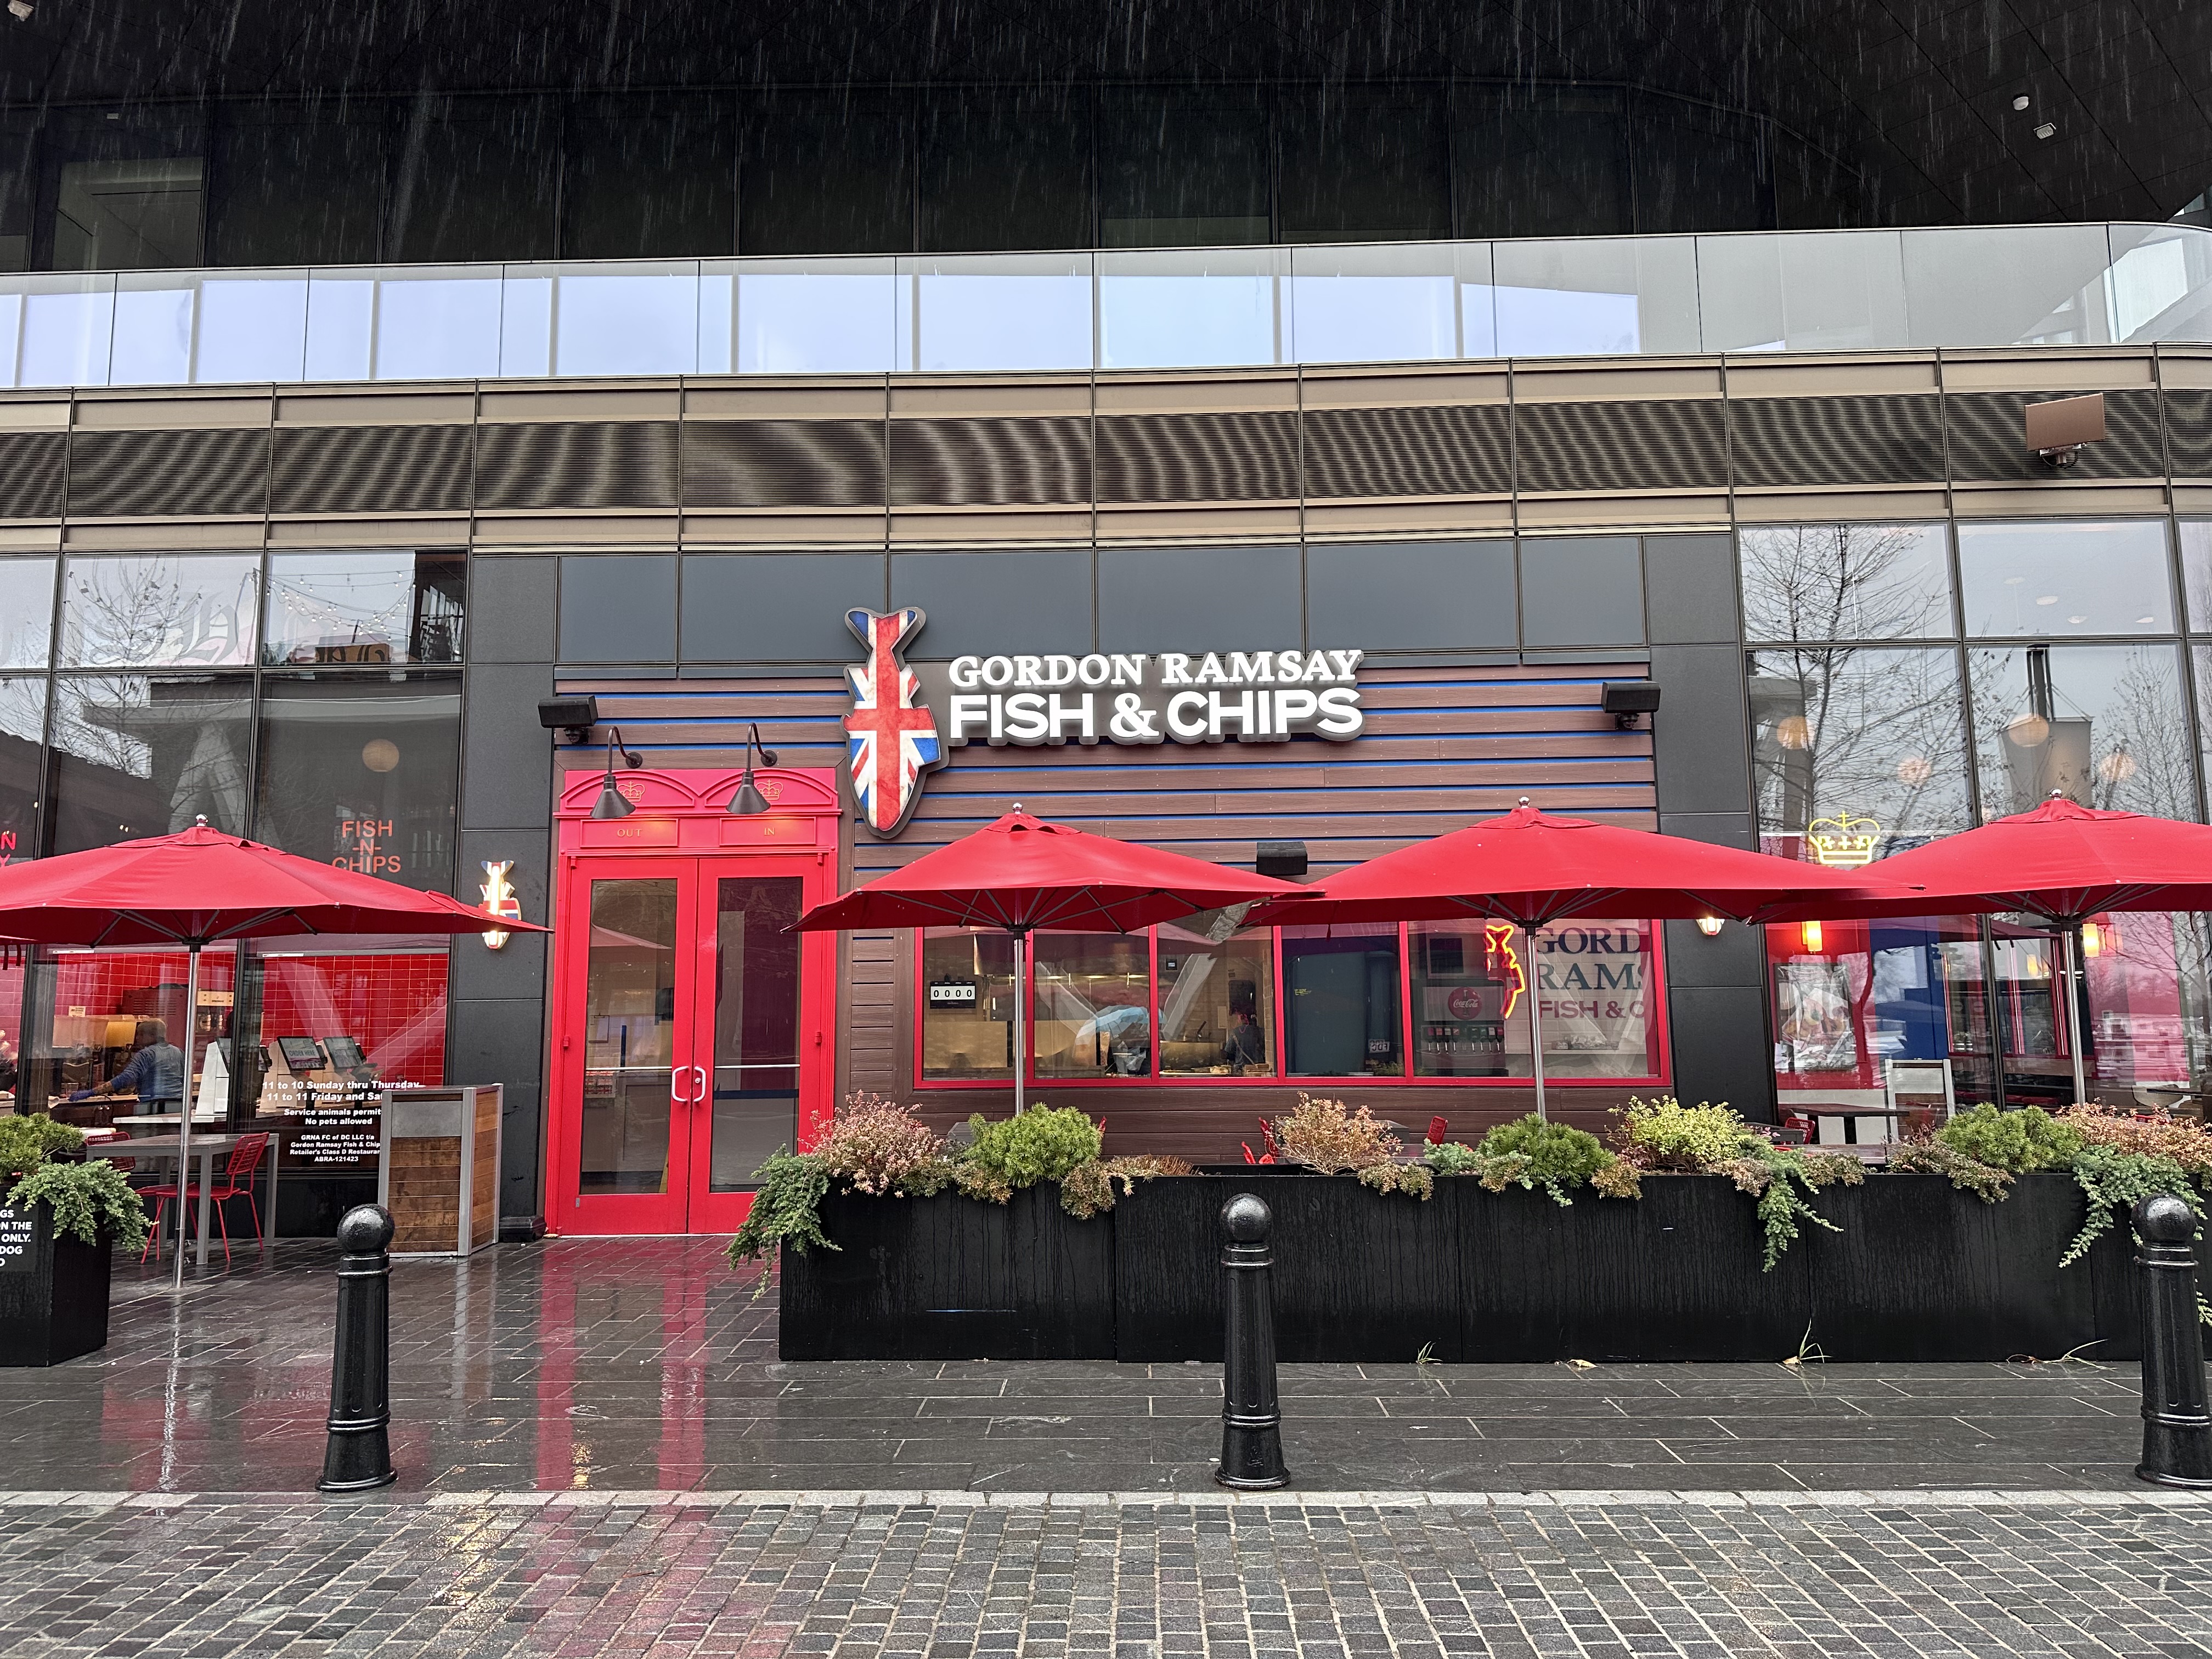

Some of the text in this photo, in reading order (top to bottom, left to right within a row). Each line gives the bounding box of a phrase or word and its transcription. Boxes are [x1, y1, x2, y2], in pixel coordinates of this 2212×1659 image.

[949, 650, 1362, 687] GORDON RAMSAY
[950, 687, 1363, 738] FISH & CHIPS
[342, 820, 393, 838] FISH
[617, 828, 642, 837] OUT
[764, 827, 775, 836] IN
[332, 855, 402, 873] CHIPS
[1539, 1000, 1599, 1019] FISH
[1605, 1000, 1627, 1018] &
[291, 1081, 304, 1089] 10
[307, 1081, 345, 1091] Sunday
[347, 1081, 368, 1089] thru
[371, 1080, 420, 1089] Thursday
[267, 1092, 278, 1101] 11
[296, 1092, 307, 1101] 11
[311, 1092, 343, 1102] Friday
[346, 1092, 364, 1101] and
[319, 1118, 337, 1126] pets
[0, 1221, 32, 1230] N THE
[1, 1233, 31, 1243] ONLY.
[0, 1245, 23, 1255] DOG
